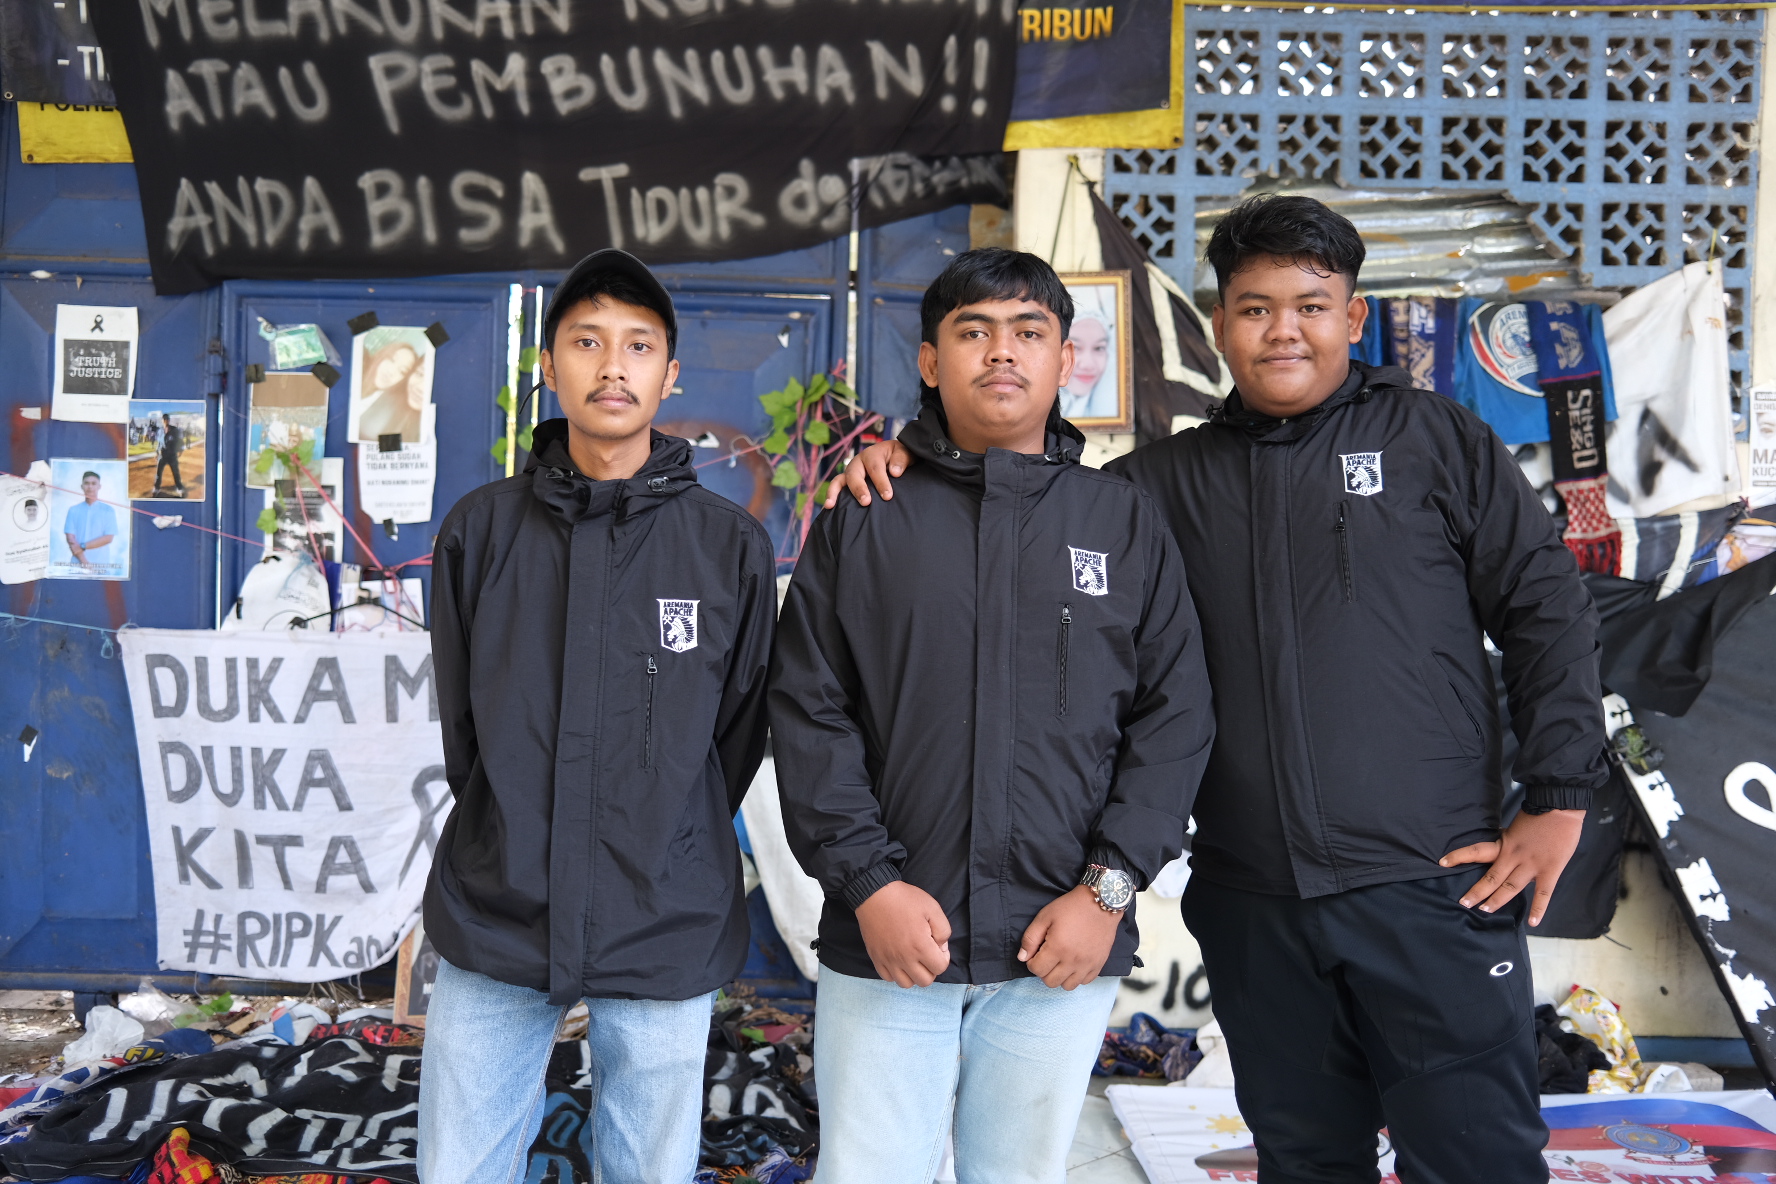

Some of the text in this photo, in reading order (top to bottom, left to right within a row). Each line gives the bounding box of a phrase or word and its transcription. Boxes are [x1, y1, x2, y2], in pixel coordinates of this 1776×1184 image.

[1018, 5, 1114, 42] RIBUN
[166, 60, 329, 132] ATAU
[167, 175, 342, 258] ANDA
[358, 168, 566, 254] BISA
[579, 163, 767, 249] TIDUR
[69, 367, 122, 379] JUSTICE
[1346, 459, 1377, 467] APACHE
[663, 607, 694, 617] APACHE
[145, 653, 440, 724] DUKA M
[158, 740, 355, 812] DUKA
[171, 825, 379, 895] KITA
[183, 908, 388, 969] #RIPKan
